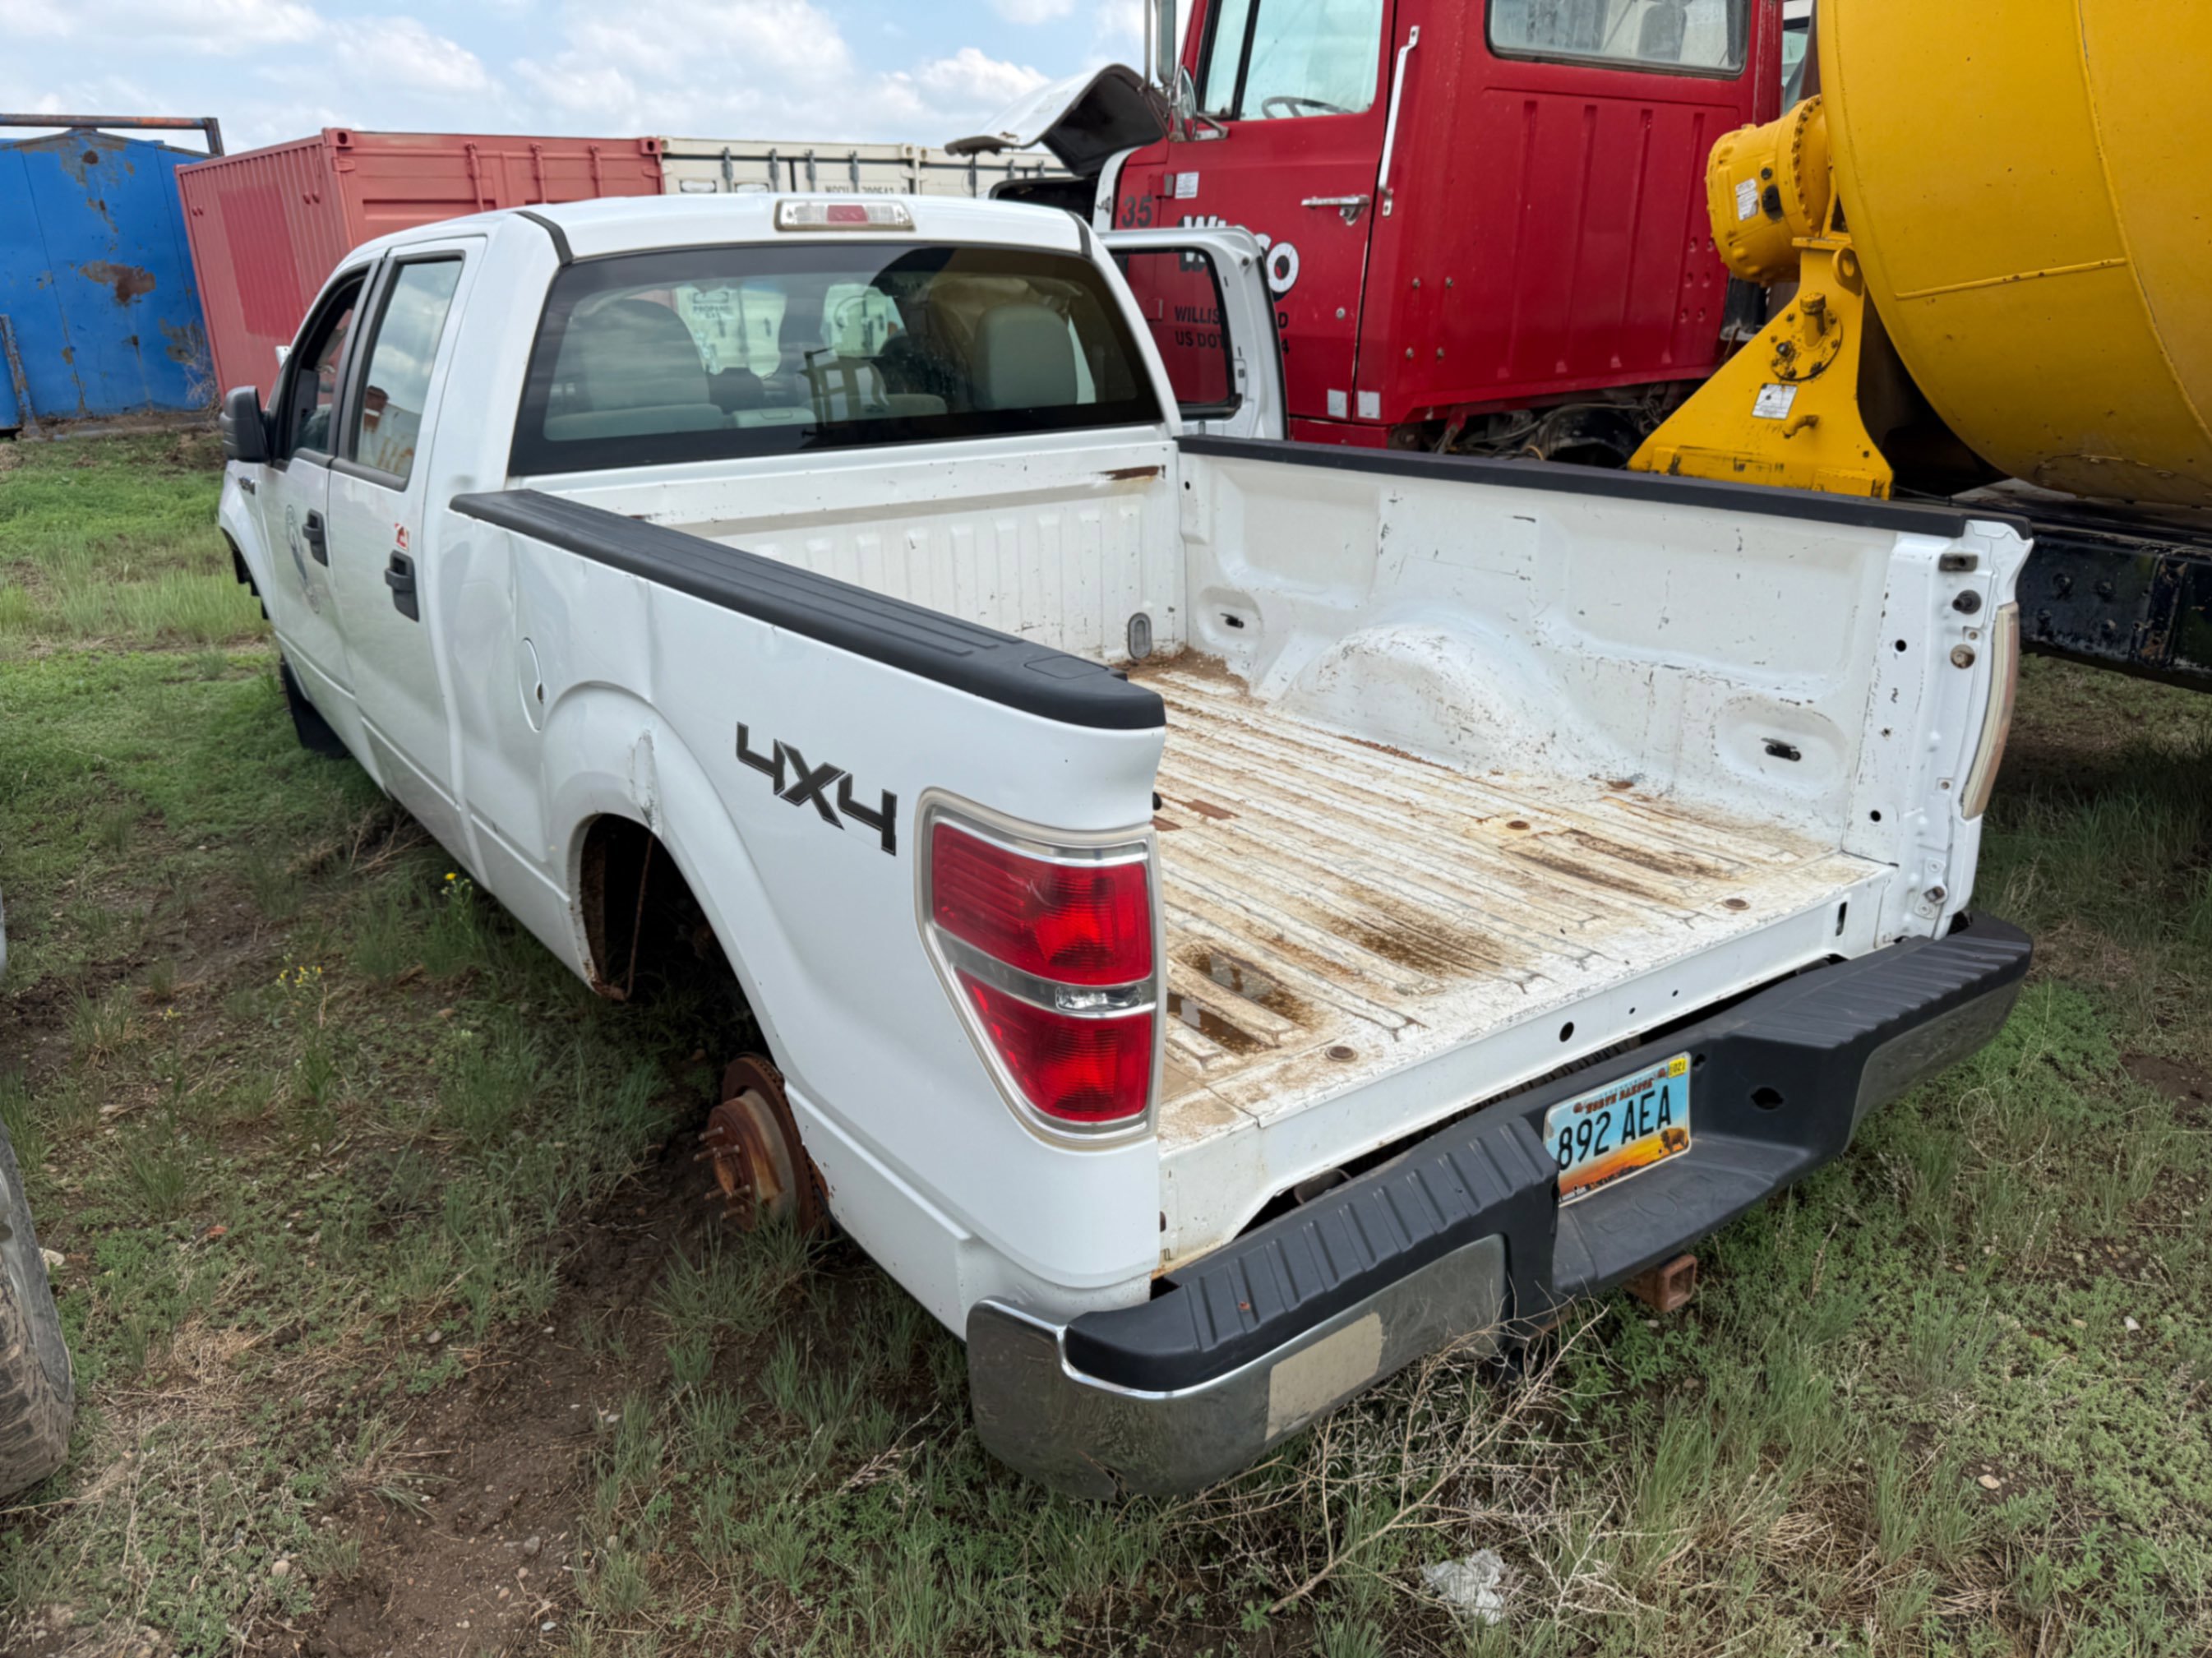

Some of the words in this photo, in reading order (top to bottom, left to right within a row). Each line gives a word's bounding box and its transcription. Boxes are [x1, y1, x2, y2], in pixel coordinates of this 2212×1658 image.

[1122, 196, 1152, 228] 35
[1175, 331, 1194, 346] US
[1559, 1111, 1610, 1171] 892
[1622, 1085, 1671, 1145] AEA
